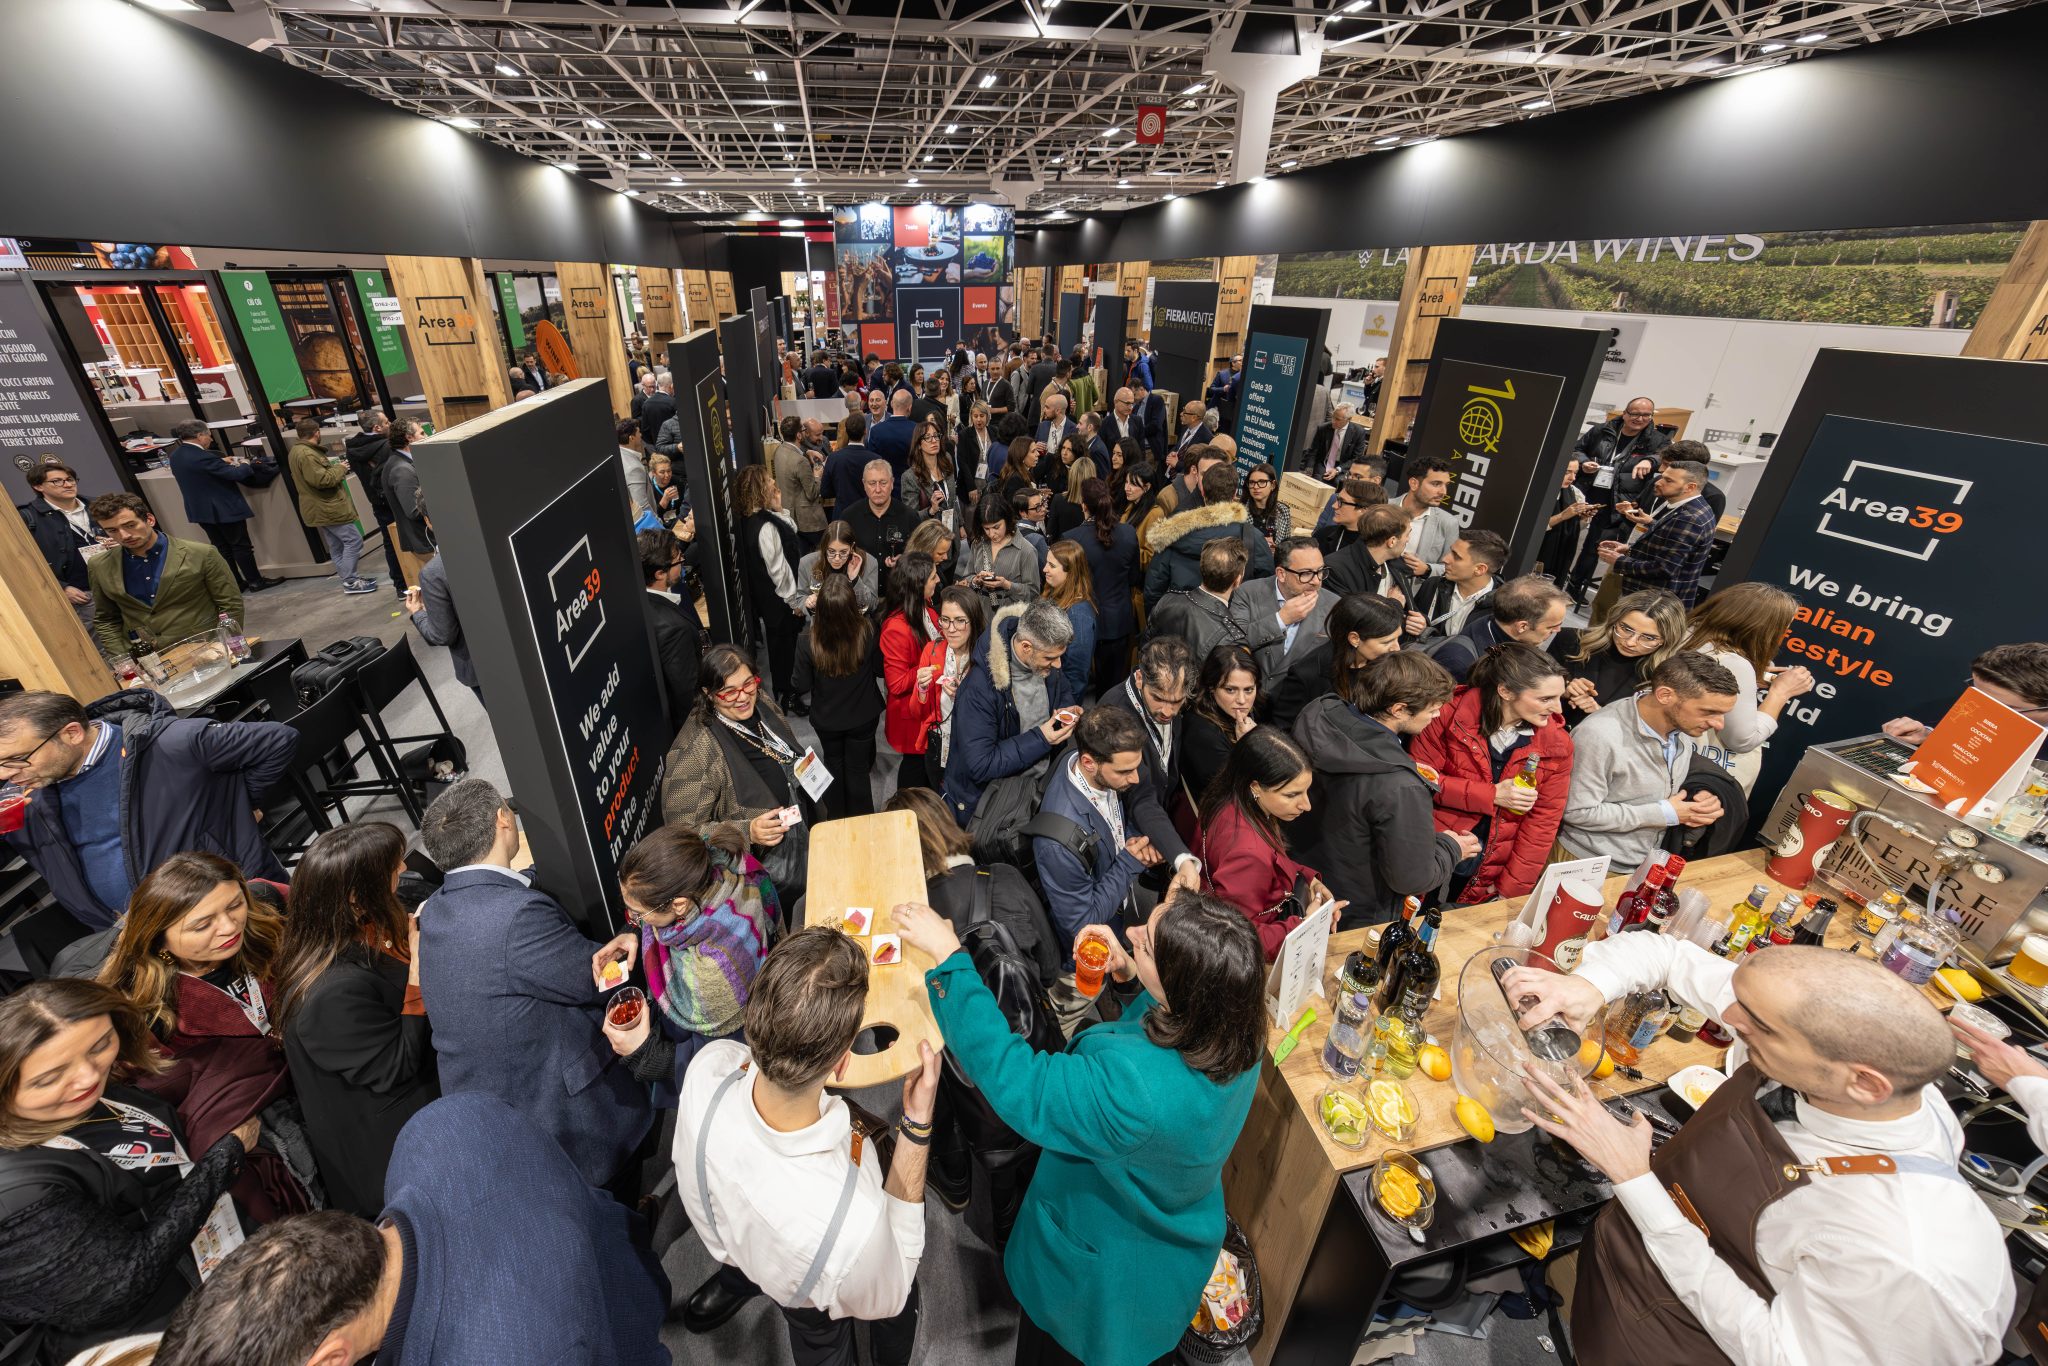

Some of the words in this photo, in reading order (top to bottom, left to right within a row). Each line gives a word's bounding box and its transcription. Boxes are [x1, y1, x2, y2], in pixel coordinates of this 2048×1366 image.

[1145, 95, 1162, 103] 6213
[1595, 232, 1766, 264] WINES
[915, 319, 945, 328] Area39
[1166, 308, 1215, 327] FIERAMENTE
[3, 343, 37, 353] UGOLINO
[12, 353, 48, 363] GIACOMO
[1, 377, 23, 387] COCCI
[22, 376, 54, 386] GRIFONI
[1250, 380, 1265, 391] Gate
[1264, 383, 1273, 393] 39
[6, 393, 17, 401] DE
[18, 391, 51, 400] ANGELIS
[1248, 392, 1265, 404] offers
[20, 415, 42, 424] VILLA
[40, 412, 81, 423] PRANDONE
[1246, 403, 1271, 417] services
[1250, 415, 1259, 425] EU
[1258, 417, 1276, 430] funds
[27, 427, 57, 437] CAPECCI
[1243, 425, 1280, 445] management,
[1, 438, 25, 447] TERRE
[25, 436, 64, 446] D'ARENGO
[1241, 435, 1266, 450] business
[1238, 456, 1249, 466] and
[1240, 446, 1268, 464] consulting
[1820, 487, 1963, 534] Area39
[555, 568, 601, 643] Area39
[1789, 564, 1840, 598] We
[1846, 584, 1953, 637] bring
[1792, 605, 1876, 646] alian
[1780, 629, 1894, 687] festyle
[579, 702, 601, 742] We
[600, 661, 621, 709] add
[588, 713, 618, 774] value
[596, 780, 610, 805] to
[608, 726, 631, 784] your
[603, 745, 641, 841] product
[610, 834, 624, 864] in
[620, 795, 637, 836] the
[1858, 827, 1998, 918] TERRE
